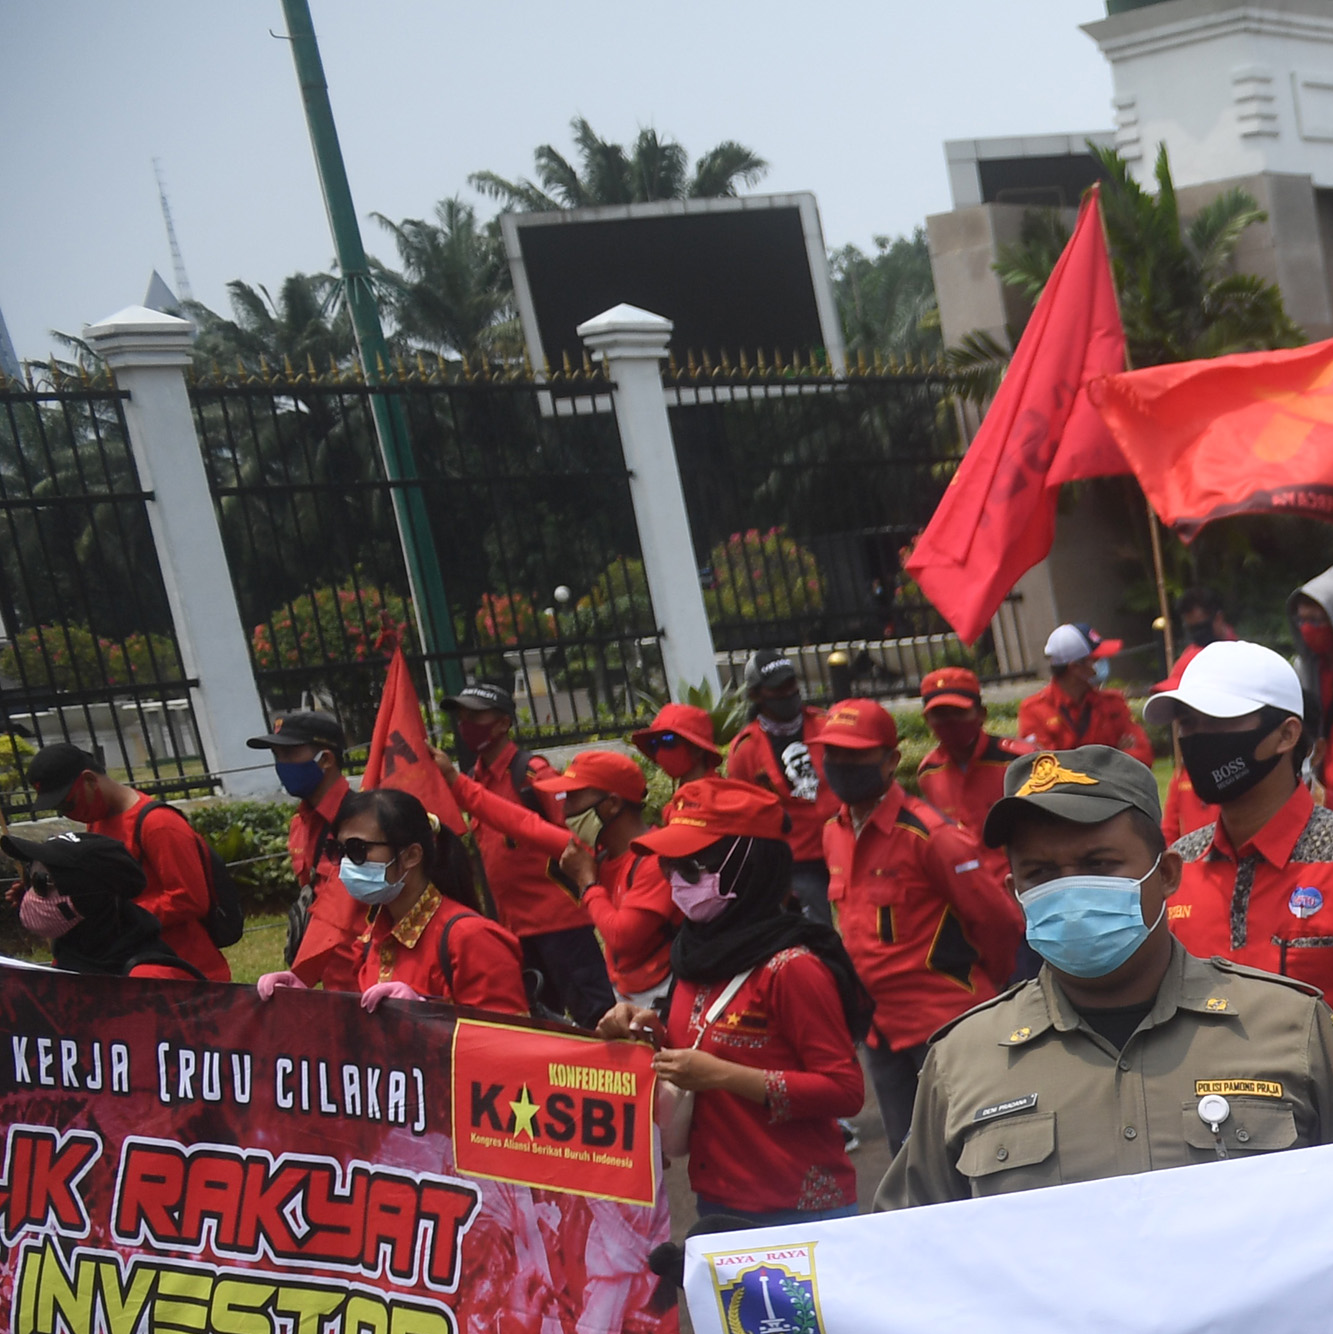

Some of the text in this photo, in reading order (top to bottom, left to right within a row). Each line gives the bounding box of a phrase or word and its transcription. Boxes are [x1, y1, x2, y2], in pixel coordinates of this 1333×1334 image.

[1211, 757, 1246, 783] BOSS
[12, 1036, 129, 1093] KERJA
[548, 1063, 637, 1097] KONFEDERASI
[1197, 1082, 1280, 1095] POLISI PAMONG PRAJA
[470, 1081, 636, 1151] KASBI
[470, 1131, 634, 1169] Kongres Aliansi Serikat Buruh Indonesia
[115, 1143, 478, 1286] RAKYAT
[715, 1249, 808, 1267] JAYA RAYA
